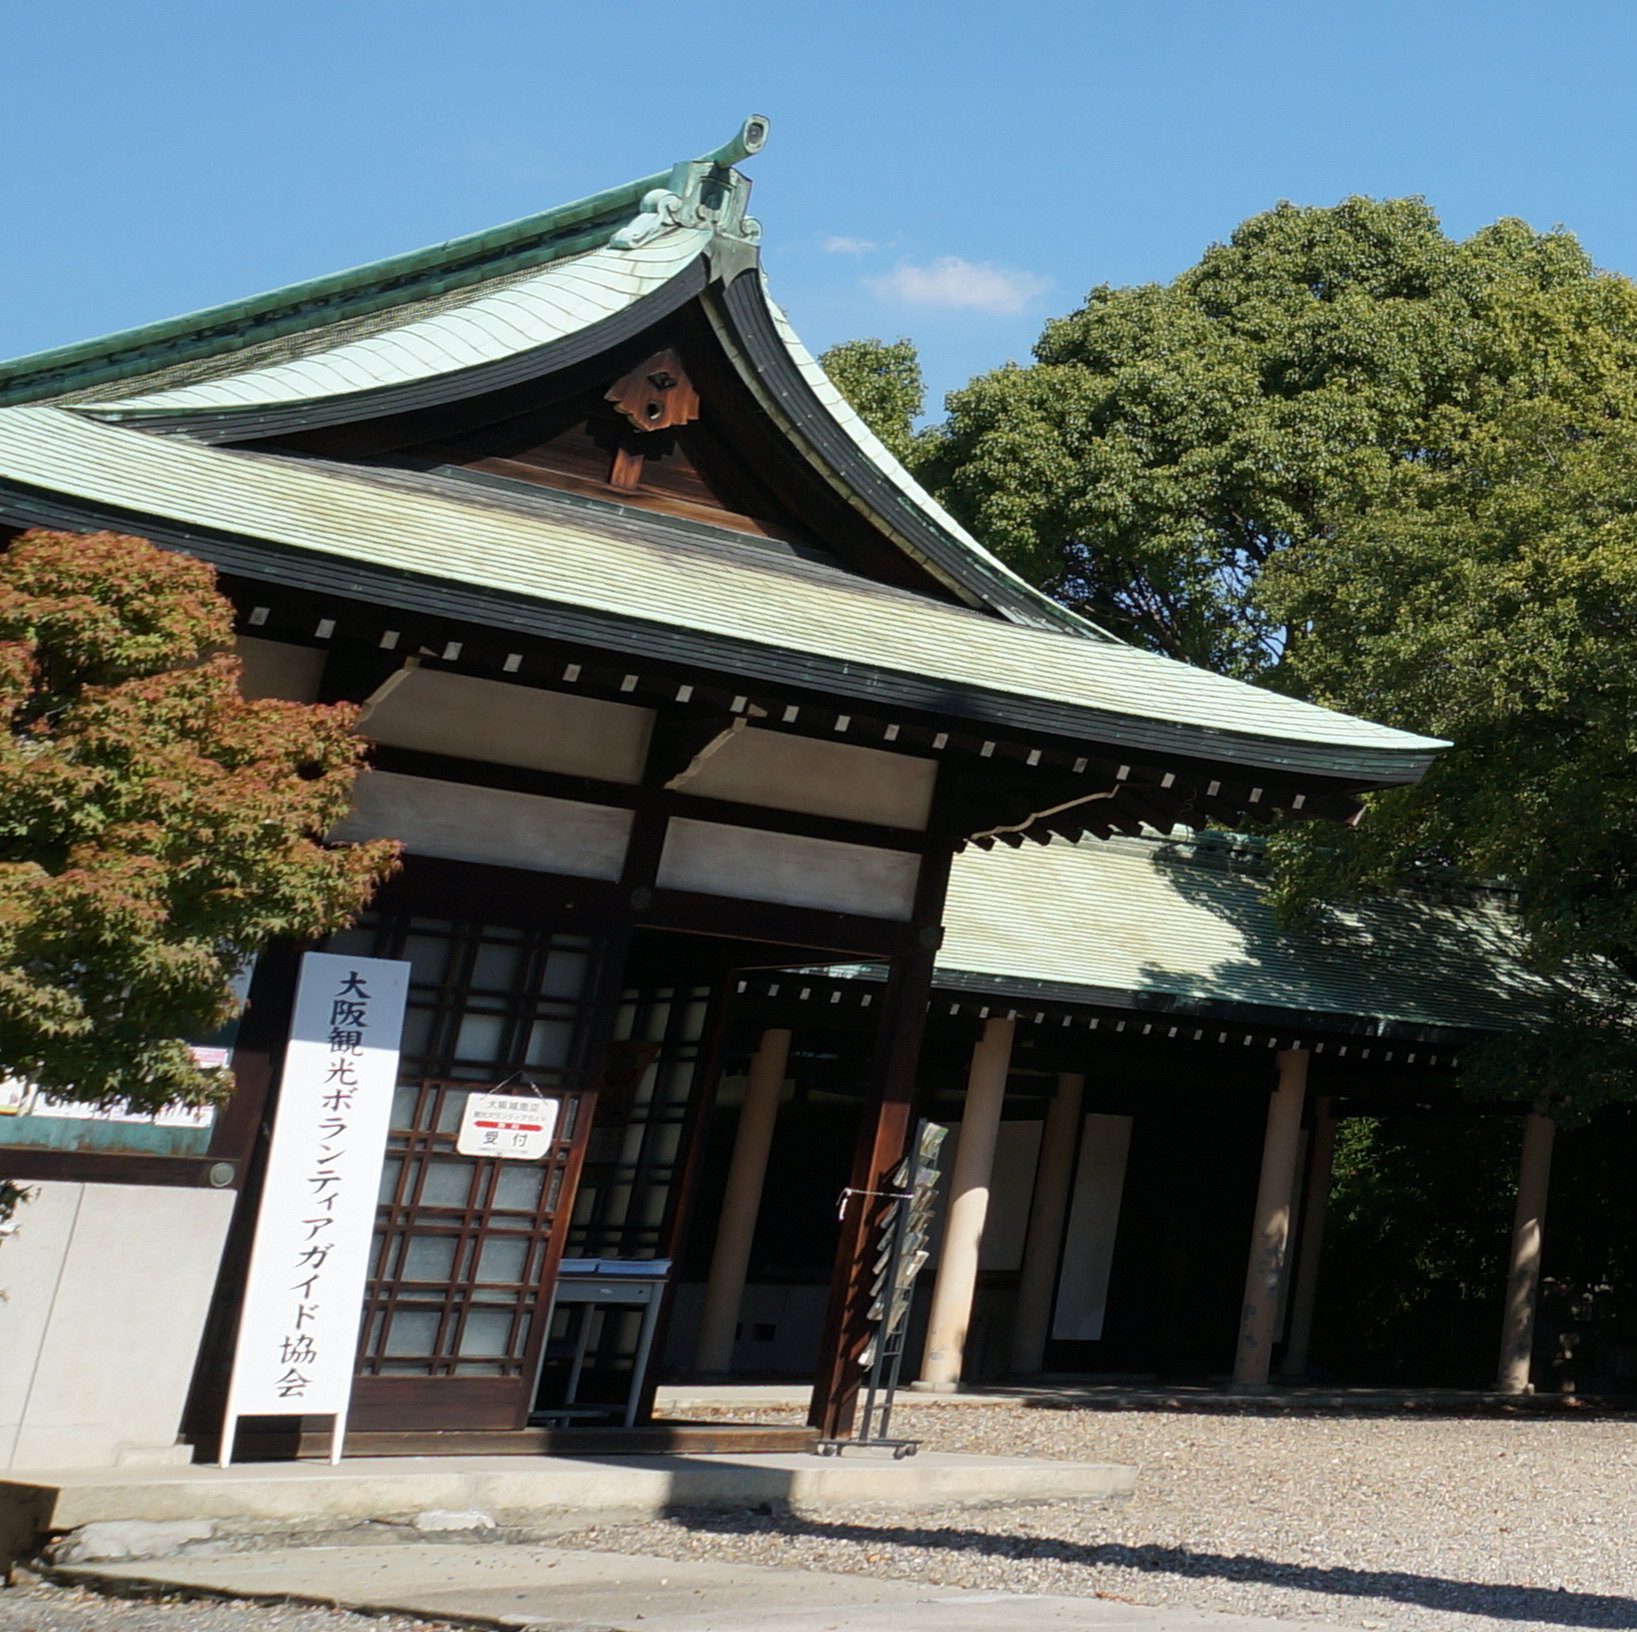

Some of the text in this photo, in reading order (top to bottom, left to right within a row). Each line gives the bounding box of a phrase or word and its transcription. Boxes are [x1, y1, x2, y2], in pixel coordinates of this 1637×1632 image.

[273, 970, 372, 1399] 大阪観光ボランティアガイド協会
[482, 1131, 528, 1147] 受付
